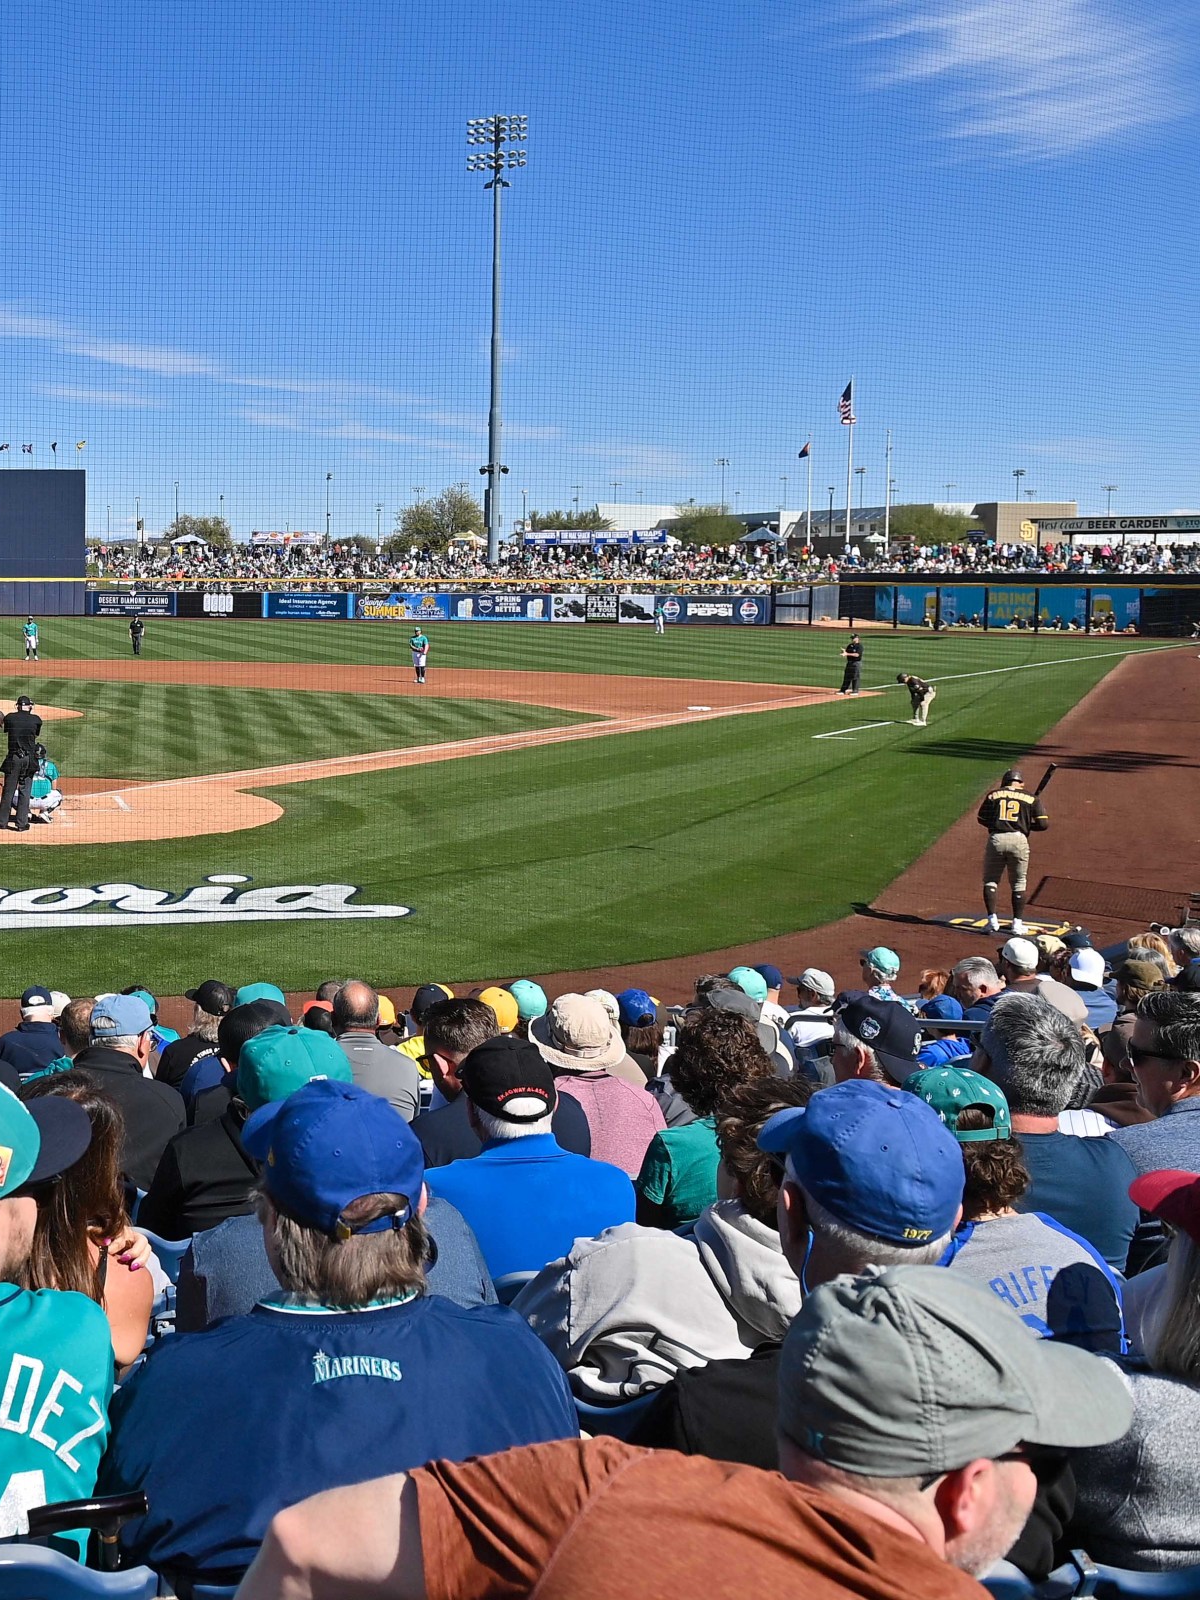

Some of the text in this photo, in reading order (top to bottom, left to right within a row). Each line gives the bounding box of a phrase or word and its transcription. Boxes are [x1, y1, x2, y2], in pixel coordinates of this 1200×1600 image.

[1020, 521, 1035, 541] SD
[1038, 520, 1058, 530] West
[1087, 520, 1116, 529] BEER
[1119, 519, 1168, 529] GARDEN
[98, 597, 169, 605] DESERT DIAMOND CASINO
[363, 604, 406, 618] SUMMER
[495, 605, 522, 613] BETTER
[687, 608, 733, 617] PEPSI
[999, 799, 1020, 822] 12
[497, 1086, 549, 1102] SKAGWAY ALASKA
[903, 1226, 933, 1240] 1977
[989, 1265, 1090, 1308] RIFFEY
[312, 1353, 403, 1385] MARINERS
